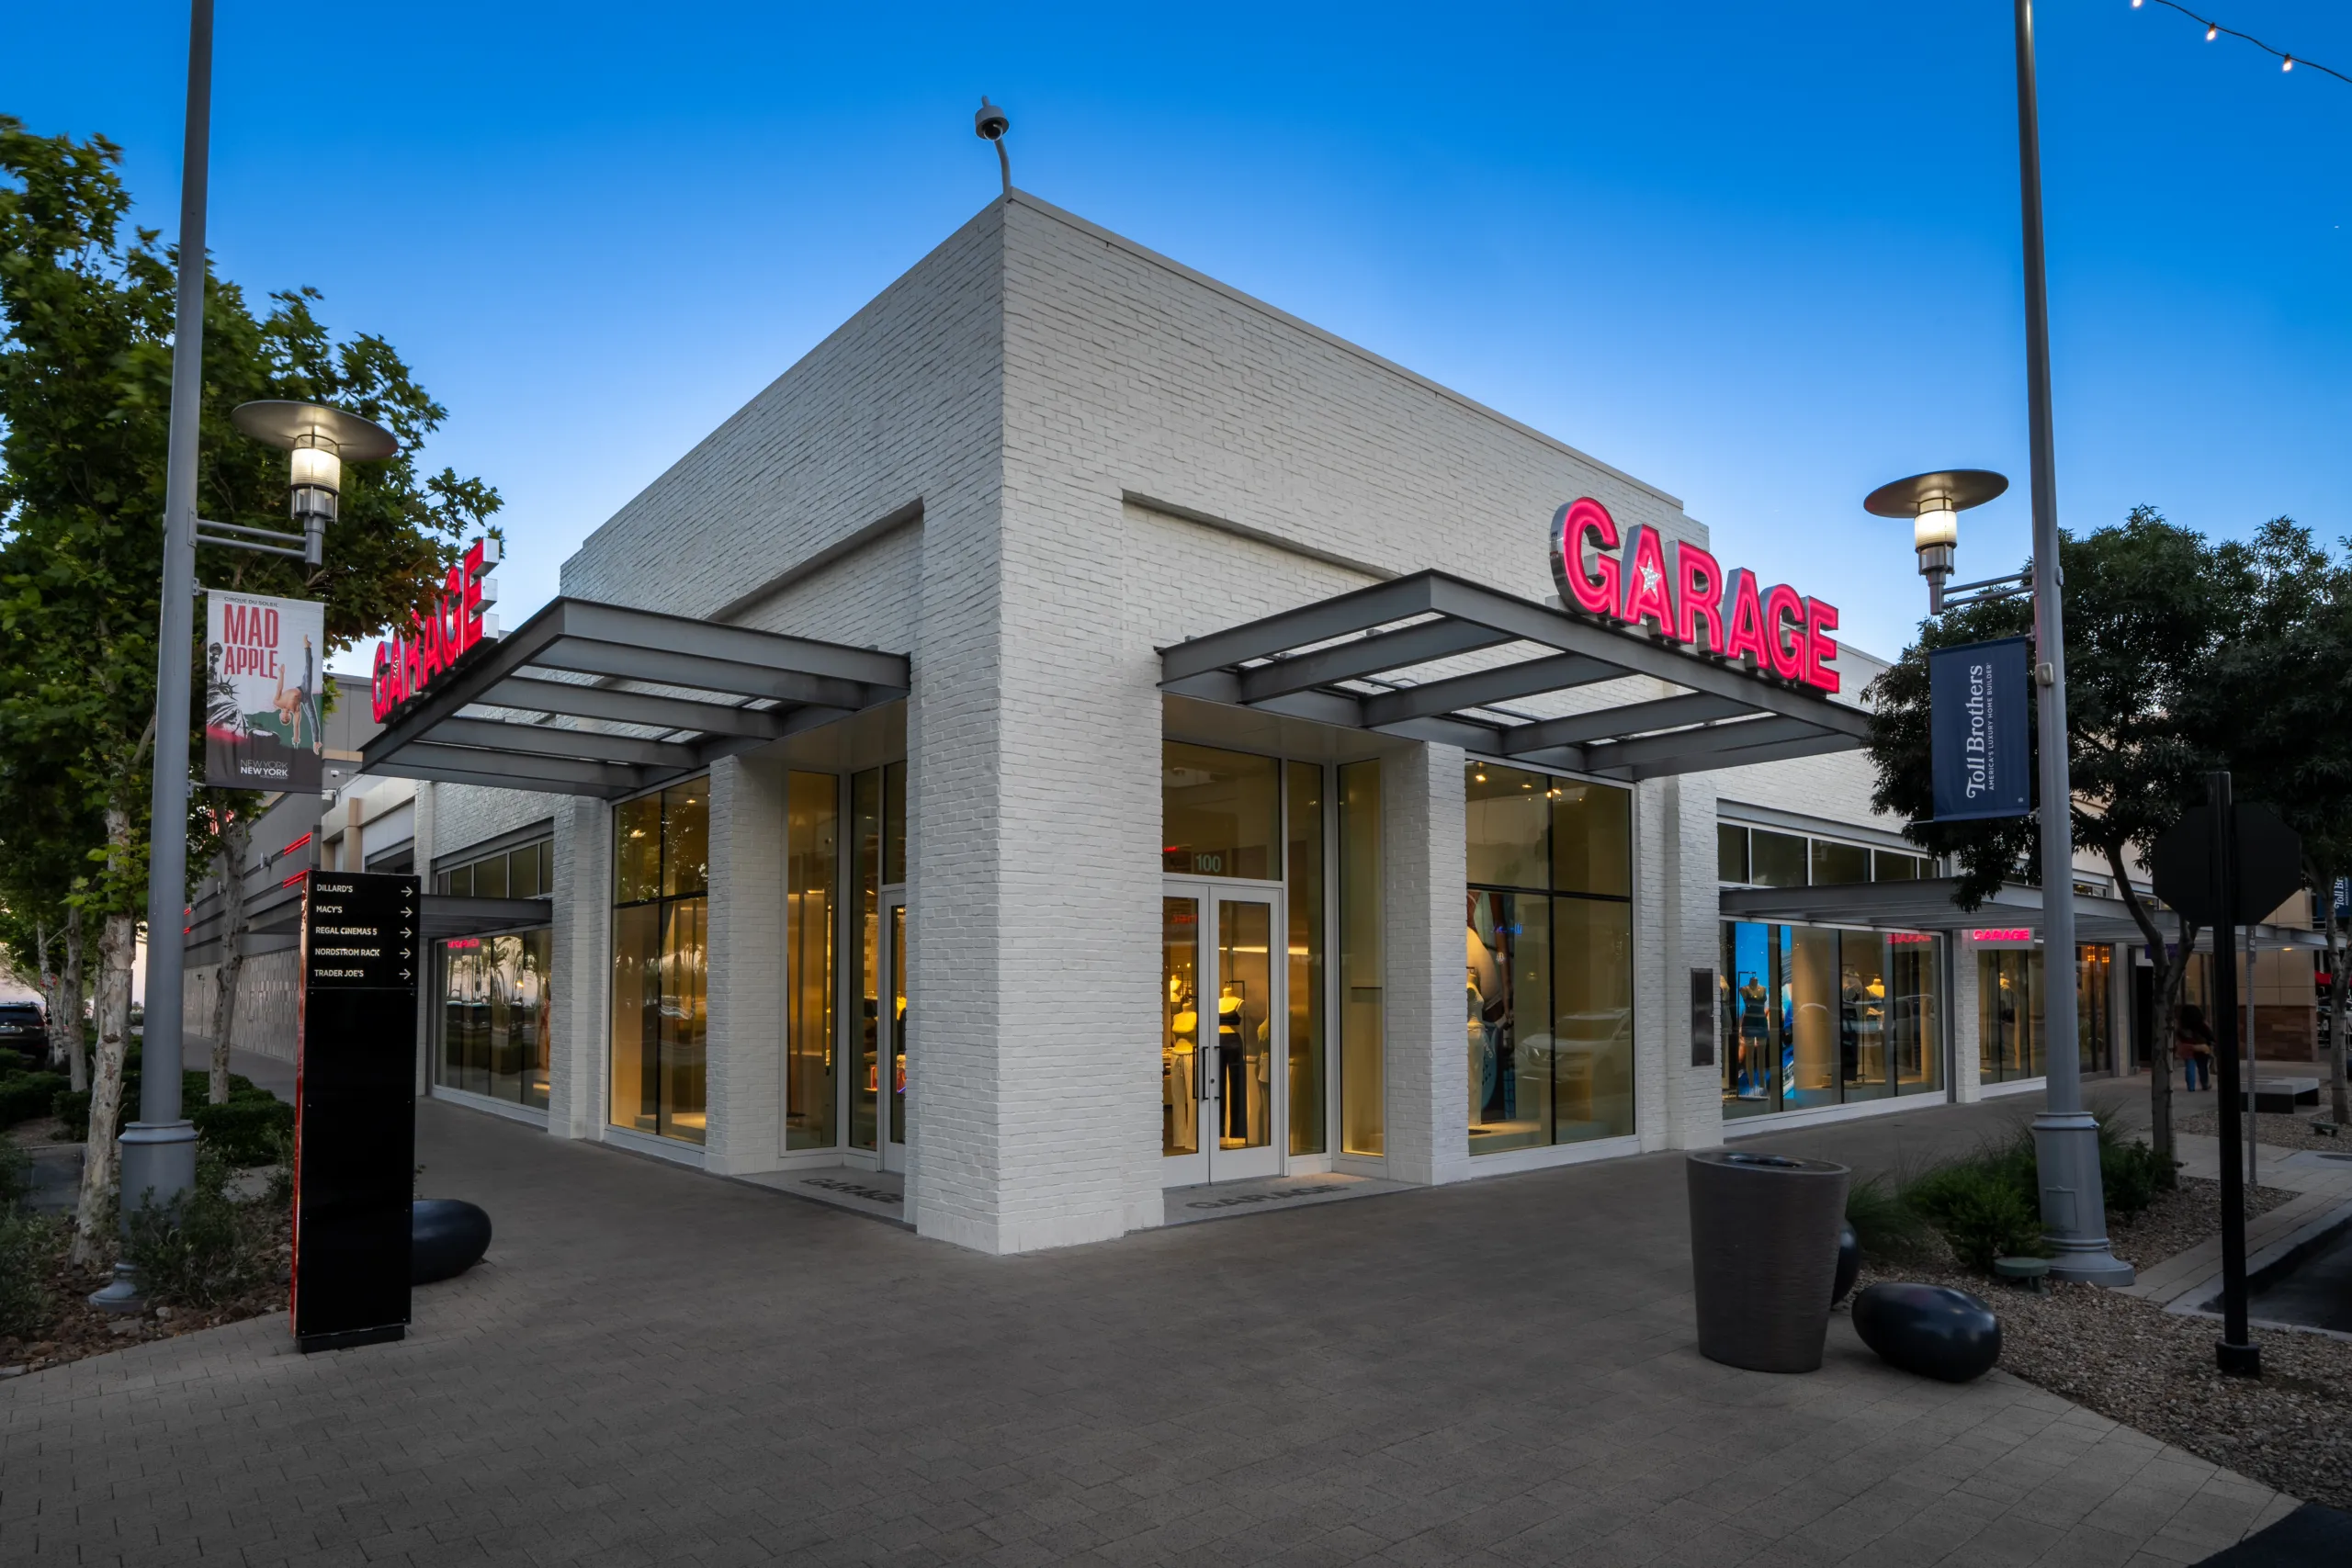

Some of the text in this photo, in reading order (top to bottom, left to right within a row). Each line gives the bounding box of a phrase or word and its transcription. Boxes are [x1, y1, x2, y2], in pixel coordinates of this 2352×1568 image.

[224, 596, 247, 604] CIRQUE
[1552, 497, 1840, 694] GARAGE
[224, 604, 278, 649] MAD
[224, 646, 278, 680] APPLE
[1965, 665, 1985, 798] Toll Brothers
[240, 759, 288, 770] NEW YORK
[240, 766, 288, 777] NEW YORK
[1195, 854, 1221, 873] 100
[316, 884, 354, 893] DILLARD'S
[316, 905, 343, 914] MACY'S
[315, 926, 378, 936] REGAL CINEMAS 5
[1973, 929, 2030, 942] GARAGE
[314, 948, 380, 957] NORDSTROM RACK
[314, 969, 344, 977] TRADER
